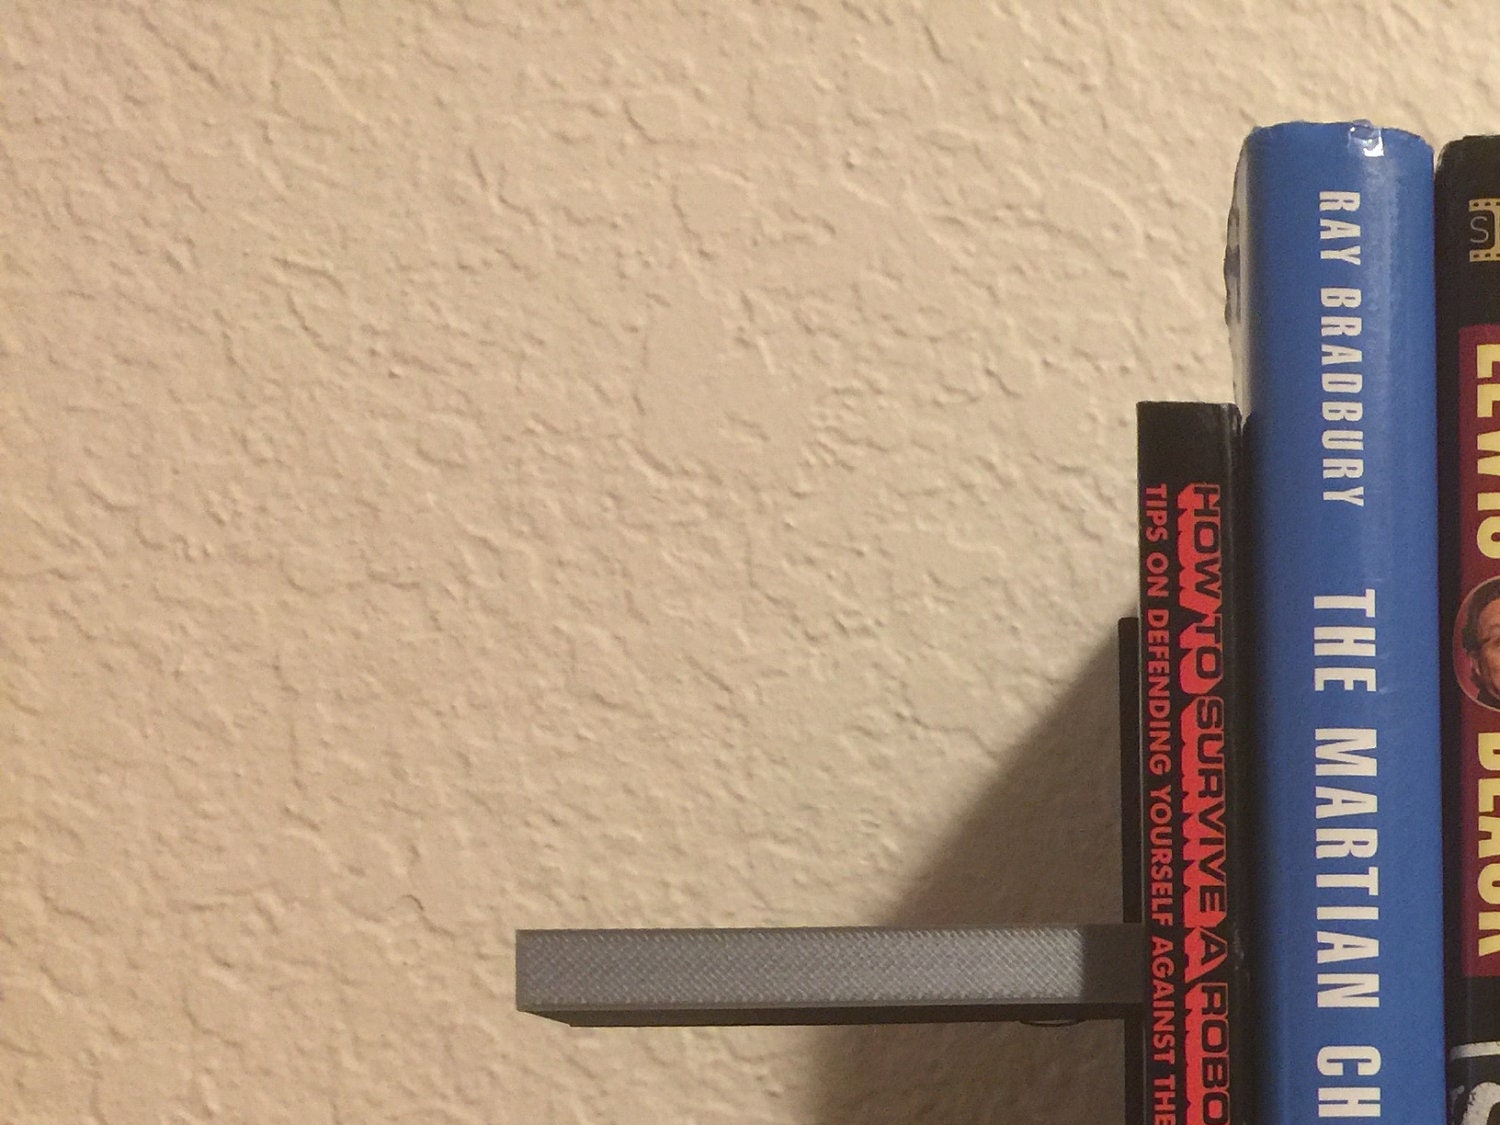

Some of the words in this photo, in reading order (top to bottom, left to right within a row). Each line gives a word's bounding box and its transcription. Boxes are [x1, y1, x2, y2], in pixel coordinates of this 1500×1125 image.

[1319, 191, 1362, 266] RAY
[1320, 288, 1365, 508] BRADBURY
[1145, 483, 1169, 542] TIPS
[1146, 552, 1170, 598] ON
[1177, 482, 1223, 612] HOW
[1147, 609, 1172, 776] DEFENDING
[1180, 613, 1224, 695] TO
[1313, 588, 1378, 693] THE
[1149, 784, 1174, 928] YOURSELF
[1180, 695, 1228, 928] SURVIVE
[1314, 727, 1381, 1009] MARTIAN
[1151, 936, 1177, 1065] AGAINST
[1184, 927, 1228, 983] A
